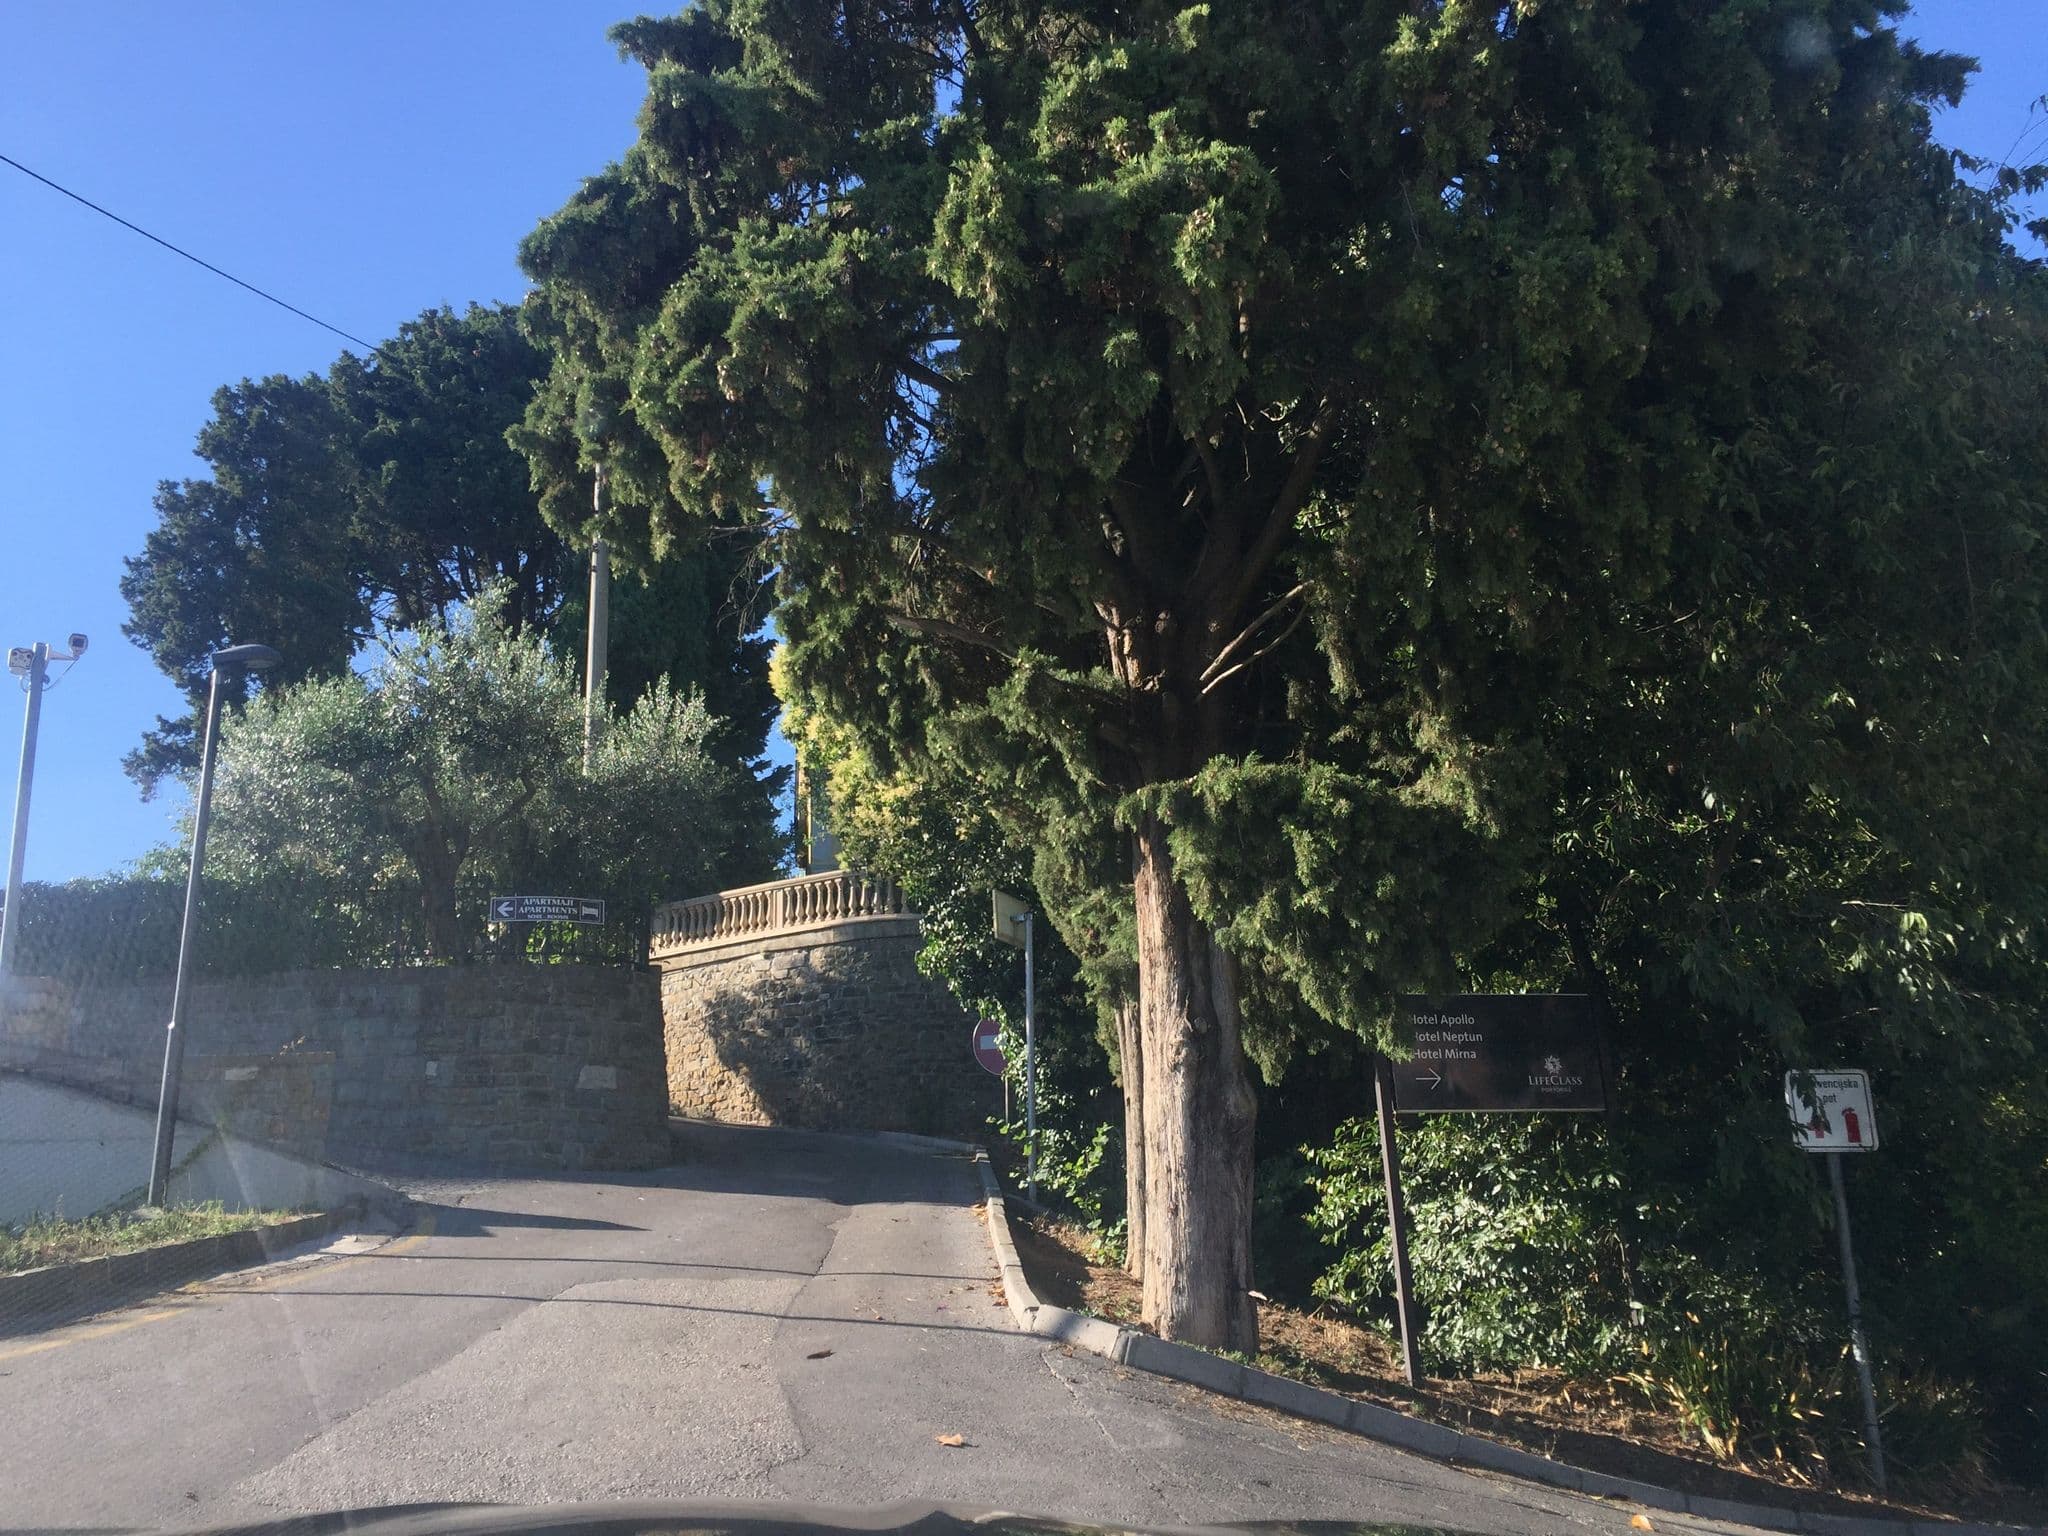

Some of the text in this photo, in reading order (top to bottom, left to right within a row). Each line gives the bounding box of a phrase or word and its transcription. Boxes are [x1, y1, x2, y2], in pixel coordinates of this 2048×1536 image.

[523, 898, 574, 906] APARTMAJI
[518, 905, 578, 915] APARTMENTS
[1440, 1014, 1475, 1027] Apollo
[1415, 1031, 1483, 1045] otel Neptun
[1445, 1048, 1477, 1059] Mirna
